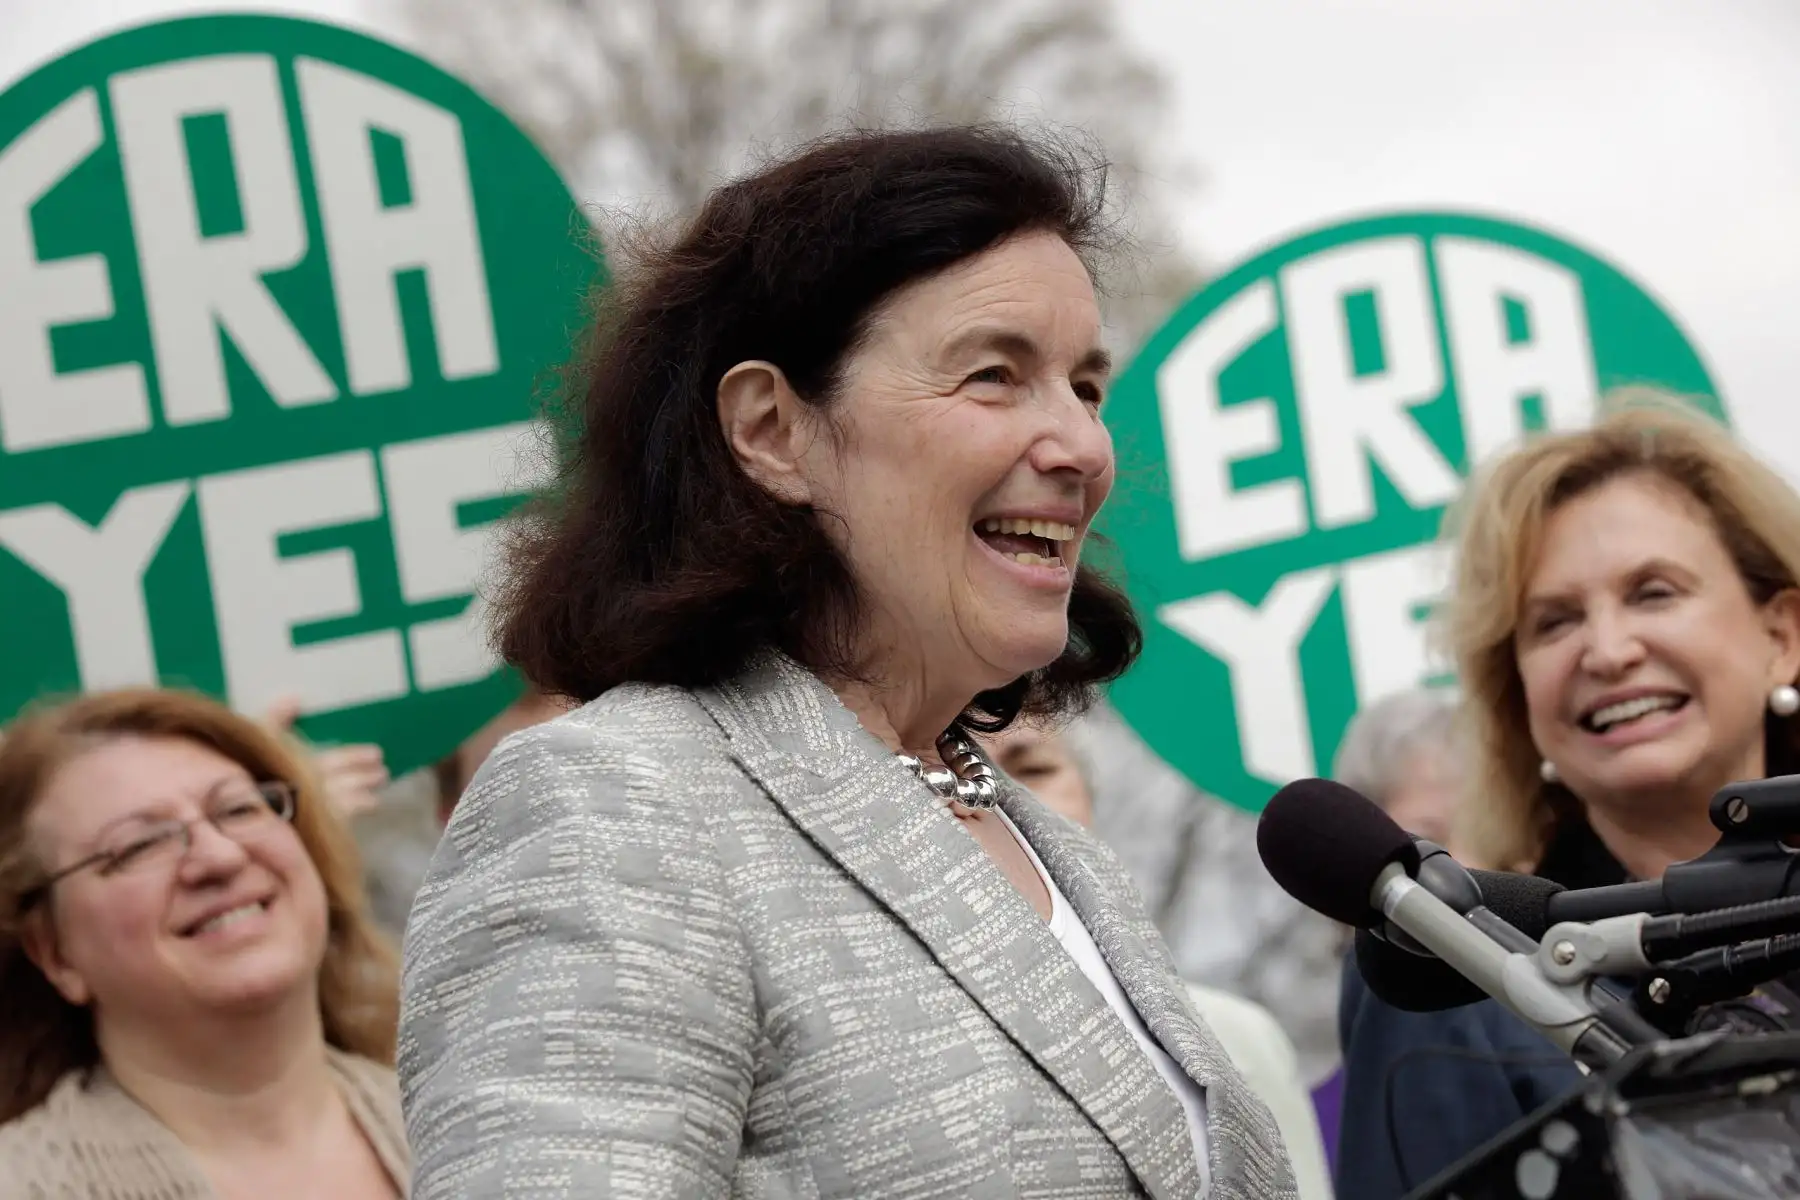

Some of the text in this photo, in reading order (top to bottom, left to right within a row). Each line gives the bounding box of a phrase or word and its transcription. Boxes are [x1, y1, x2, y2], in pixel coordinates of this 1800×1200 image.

[0, 53, 500, 453] ERA
[1155, 234, 1600, 562] ERA
[1157, 541, 1463, 786] YE
